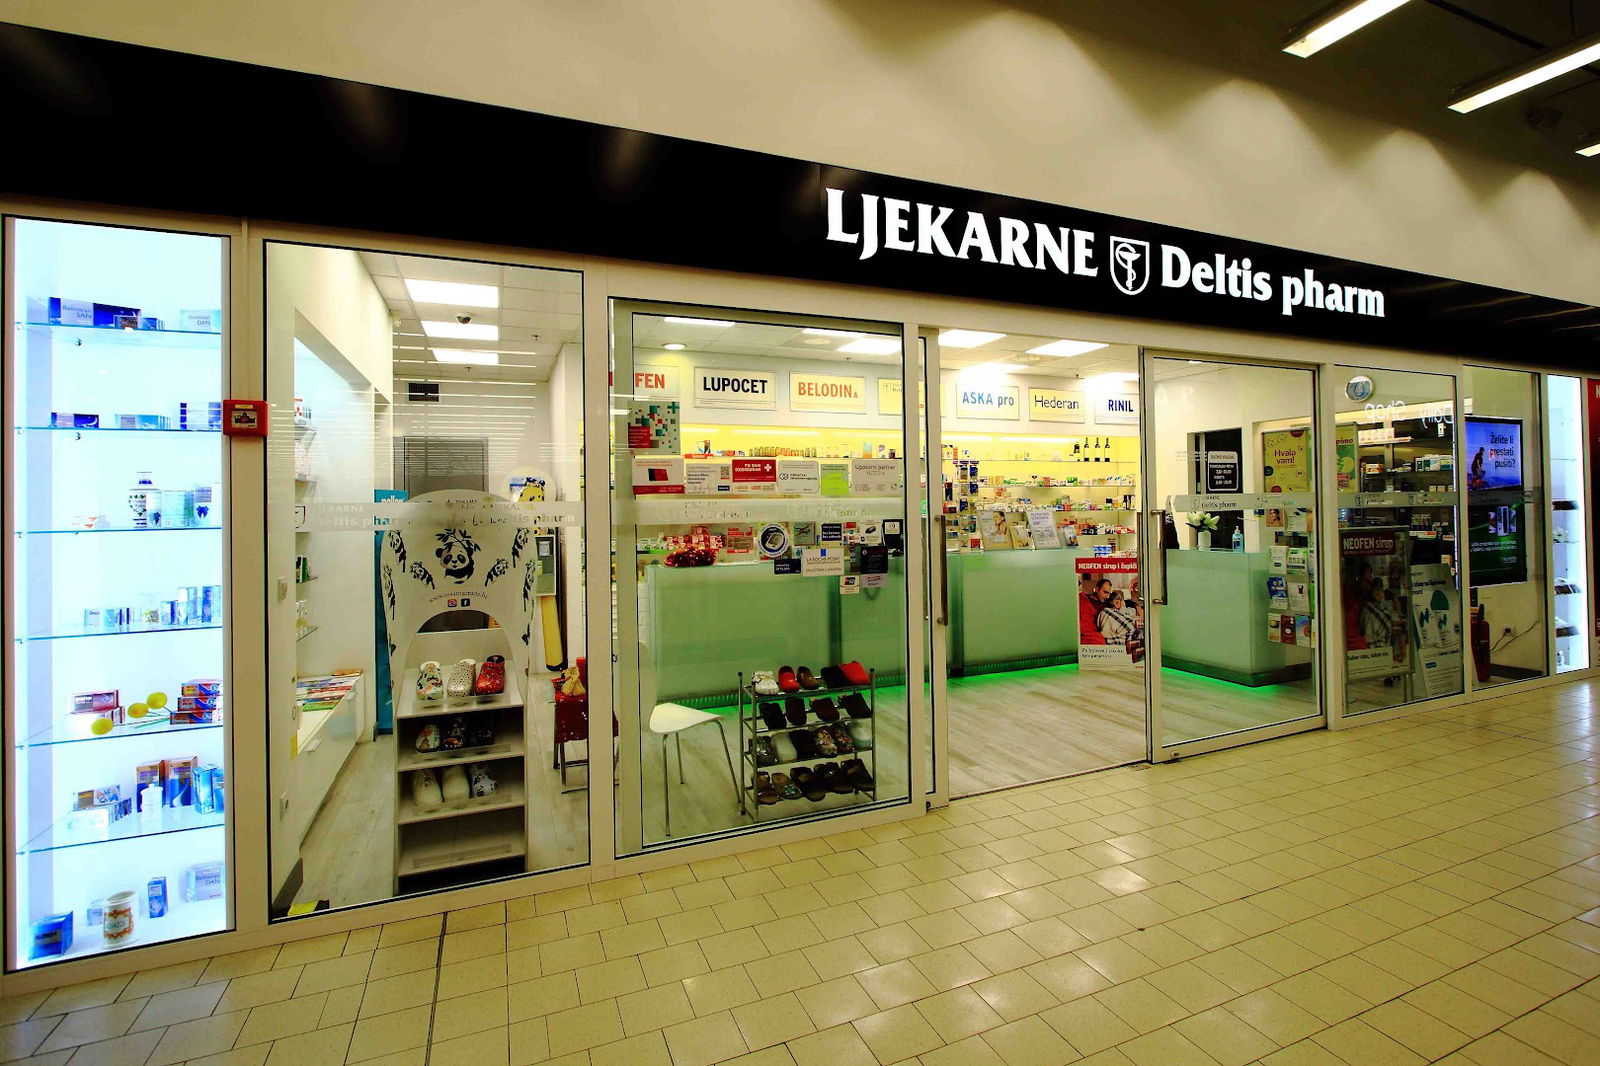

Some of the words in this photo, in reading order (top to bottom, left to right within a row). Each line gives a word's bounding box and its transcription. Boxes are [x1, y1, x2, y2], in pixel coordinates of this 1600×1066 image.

[825, 187, 1098, 278] LJEKARNE
[1160, 244, 1272, 302] Deltis
[1281, 268, 1386, 318] pharm
[703, 376, 768, 394] LUPOCET
[797, 381, 852, 398] BELODIN
[962, 391, 994, 405] ASKA
[997, 394, 1014, 408] pro
[1034, 394, 1080, 410] Hederan
[1108, 399, 1134, 412] RINIL
[1489, 432, 1508, 444] Želite
[1274, 449, 1297, 457] Hvala
[1276, 456, 1295, 464] vam!
[1489, 446, 1514, 460] prestati
[1343, 537, 1375, 550] NEOFEN
